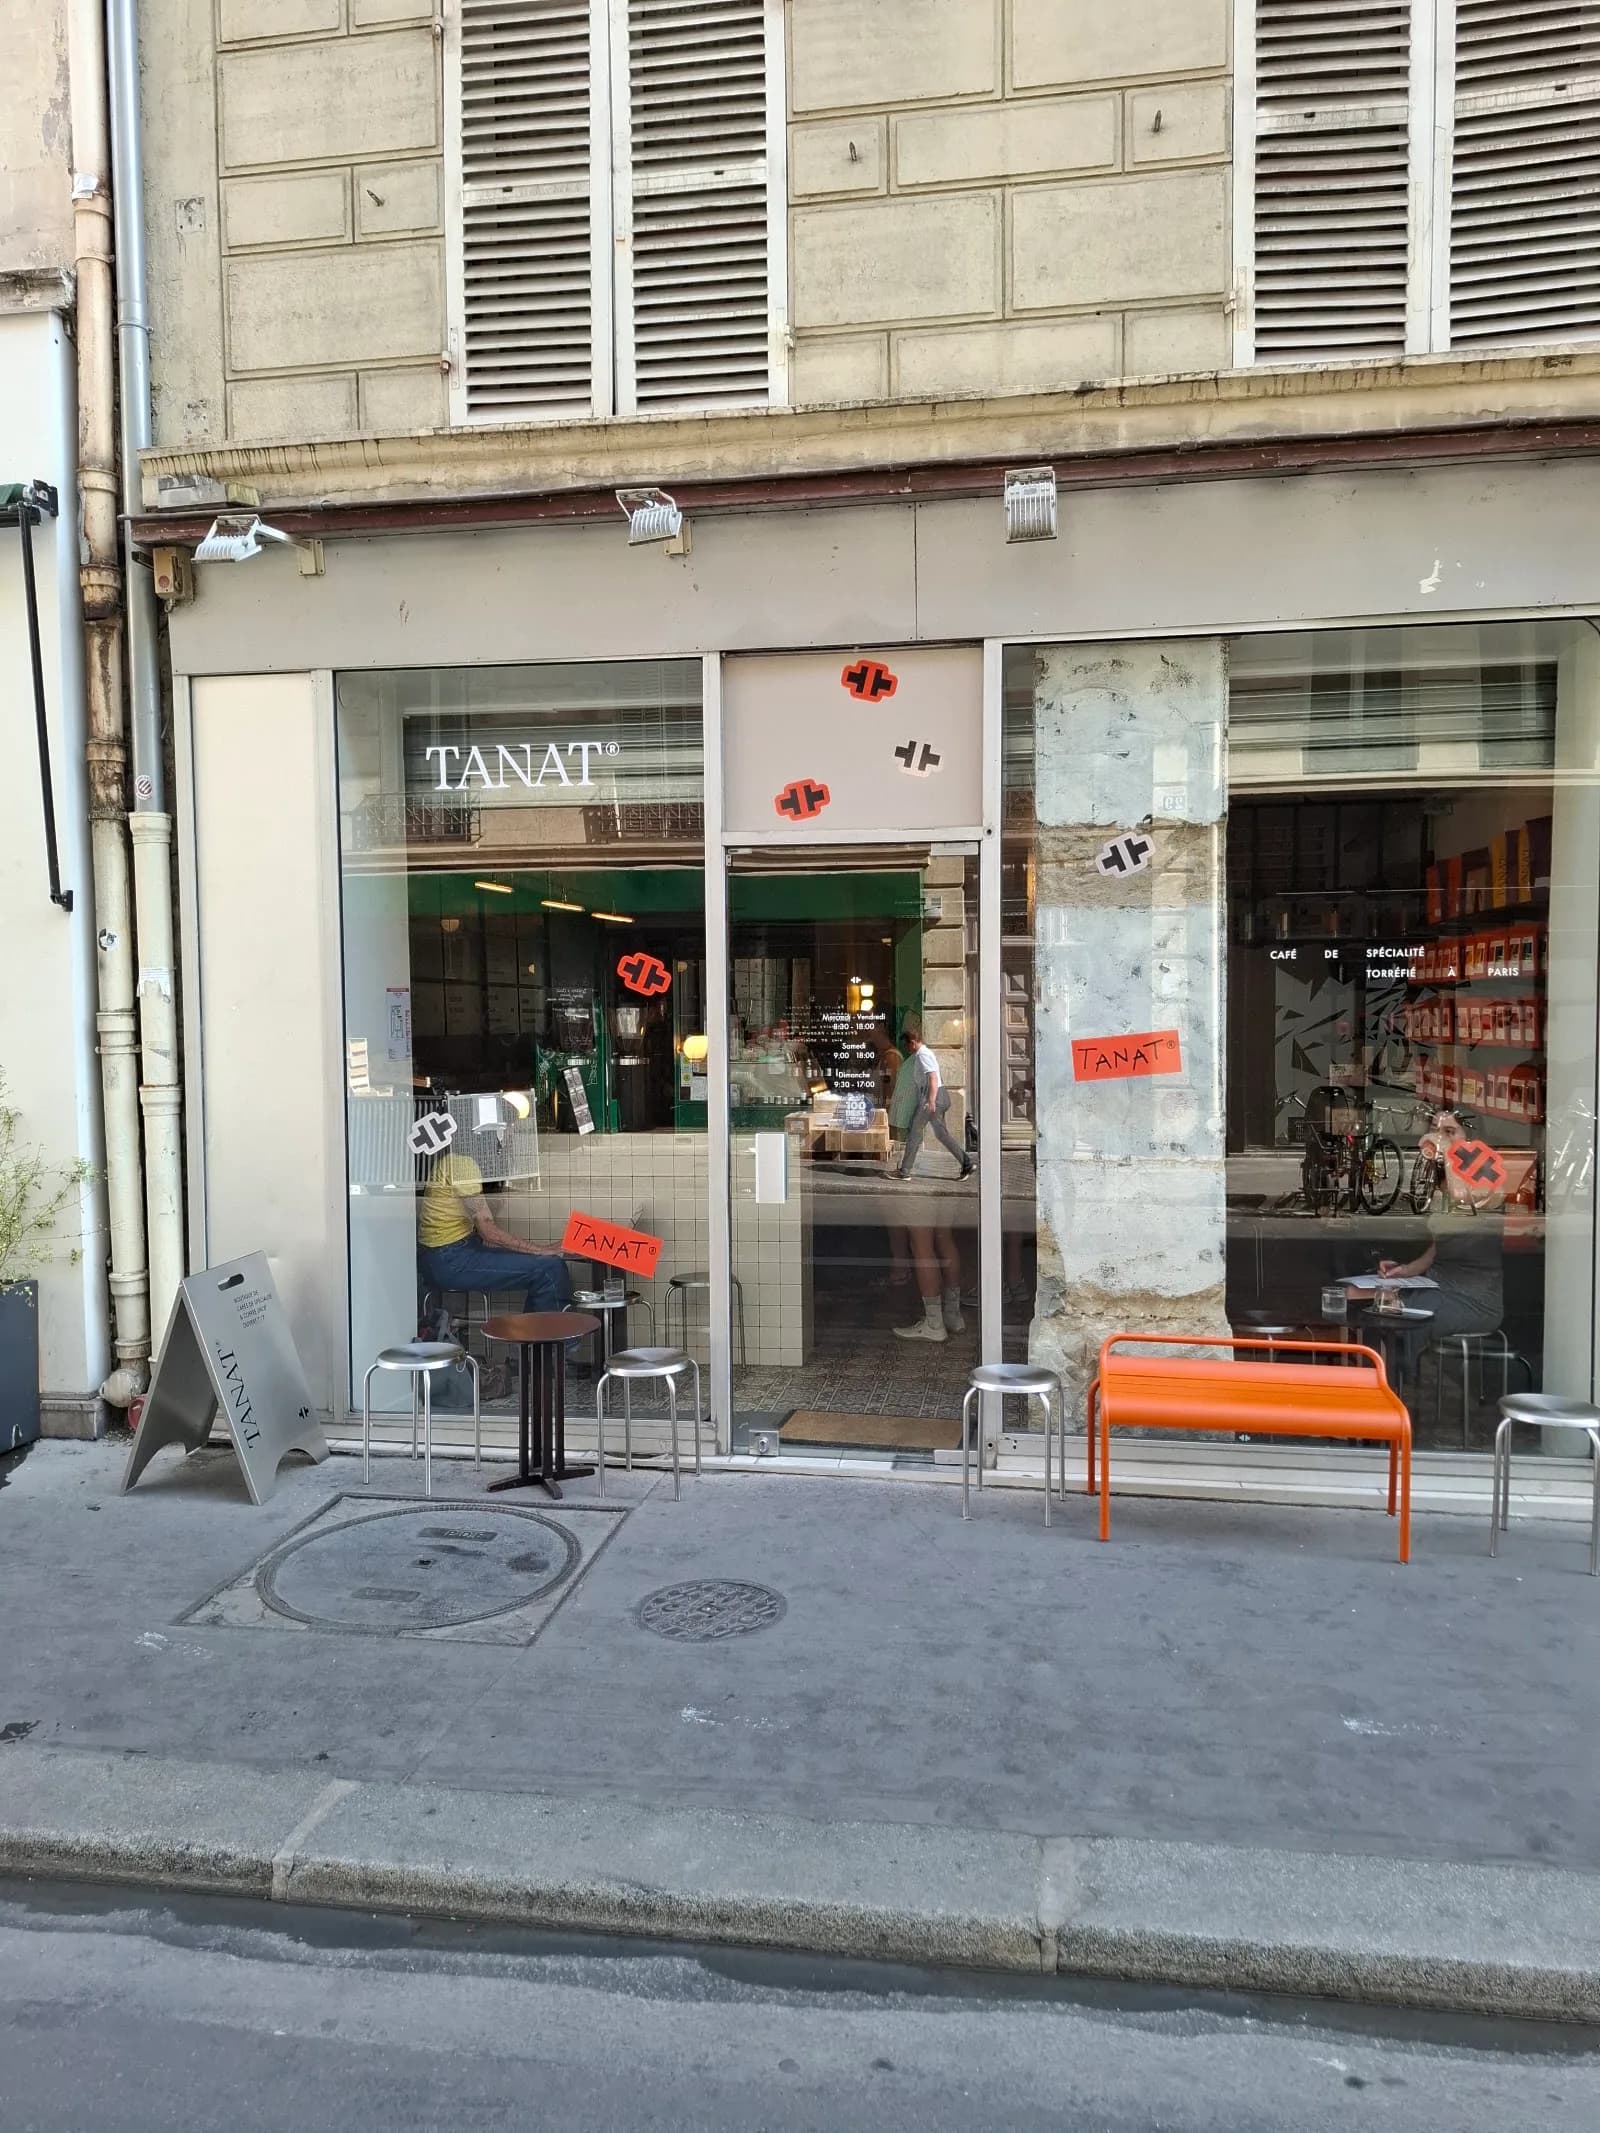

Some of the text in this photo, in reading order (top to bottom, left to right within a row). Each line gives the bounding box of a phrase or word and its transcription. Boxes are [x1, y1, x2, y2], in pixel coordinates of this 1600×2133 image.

[1270, 945, 1425, 960] CAFÉ DE SPÉCIALITÉ
[1366, 966, 1519, 978] TORRÉFIÉ À PARIS
[856, 1013, 886, 1021] Vendredi
[842, 1042, 866, 1050] Samedi
